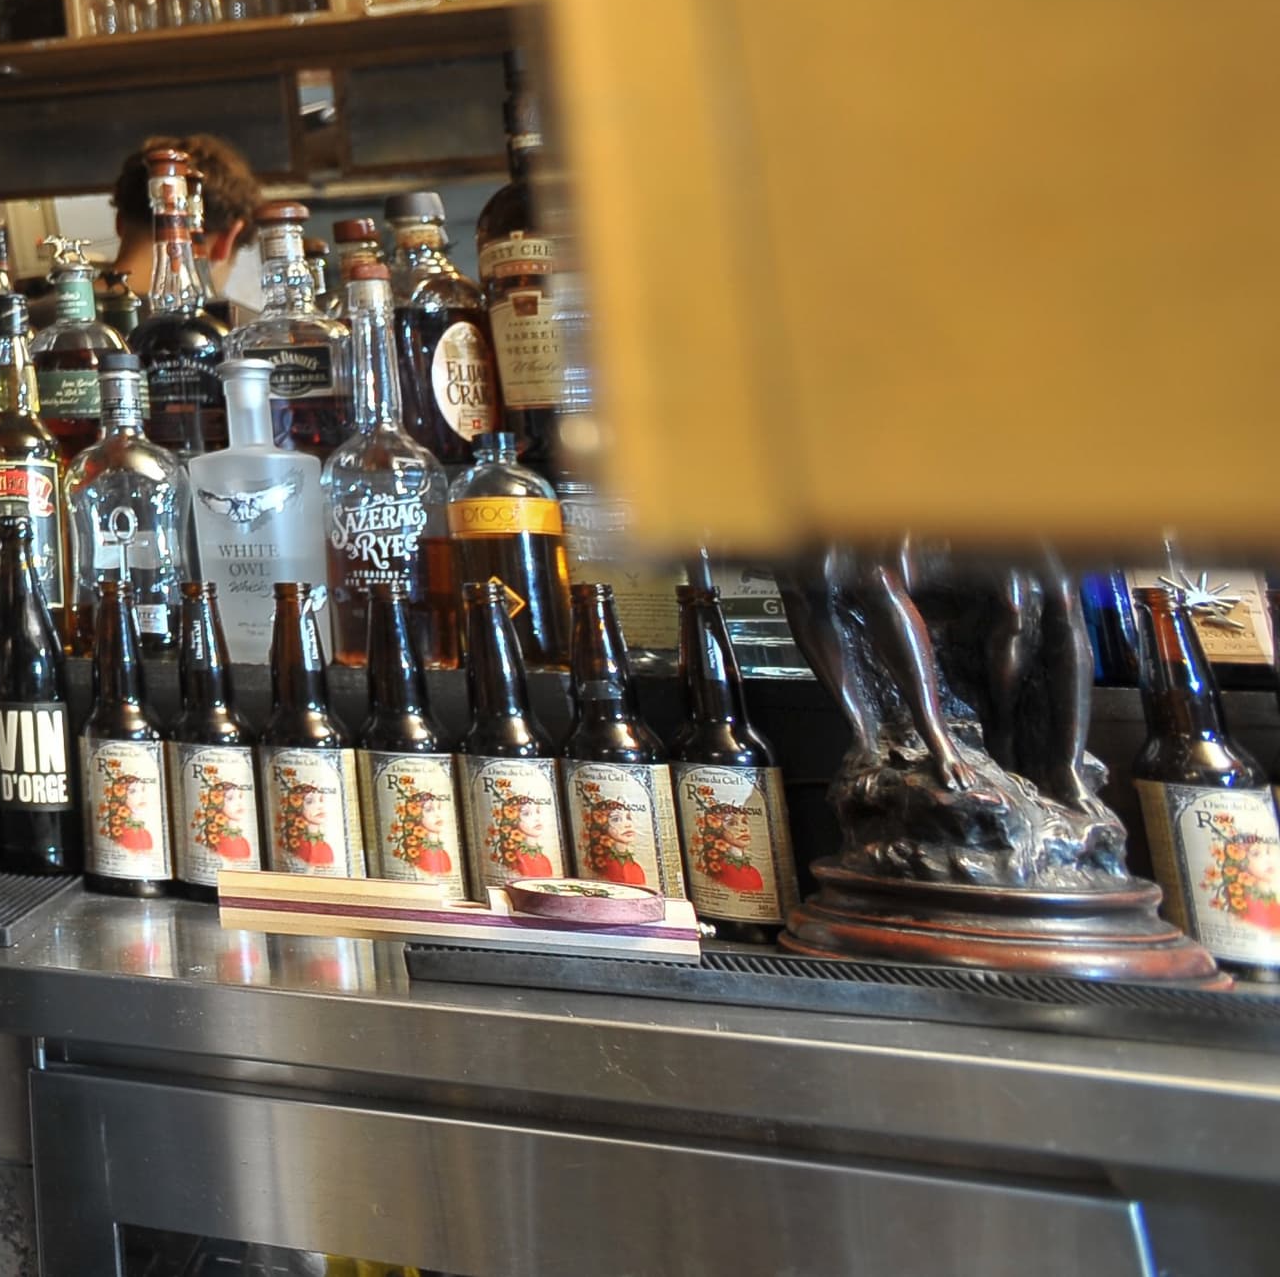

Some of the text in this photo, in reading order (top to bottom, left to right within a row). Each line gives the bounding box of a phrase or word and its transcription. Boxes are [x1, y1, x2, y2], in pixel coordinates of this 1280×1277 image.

[331, 502, 428, 550] SAZERAC
[218, 544, 281, 558] WHITE
[346, 531, 418, 570] RYE
[228, 561, 272, 577] OWL
[1, 772, 69, 805] D'ORGE
